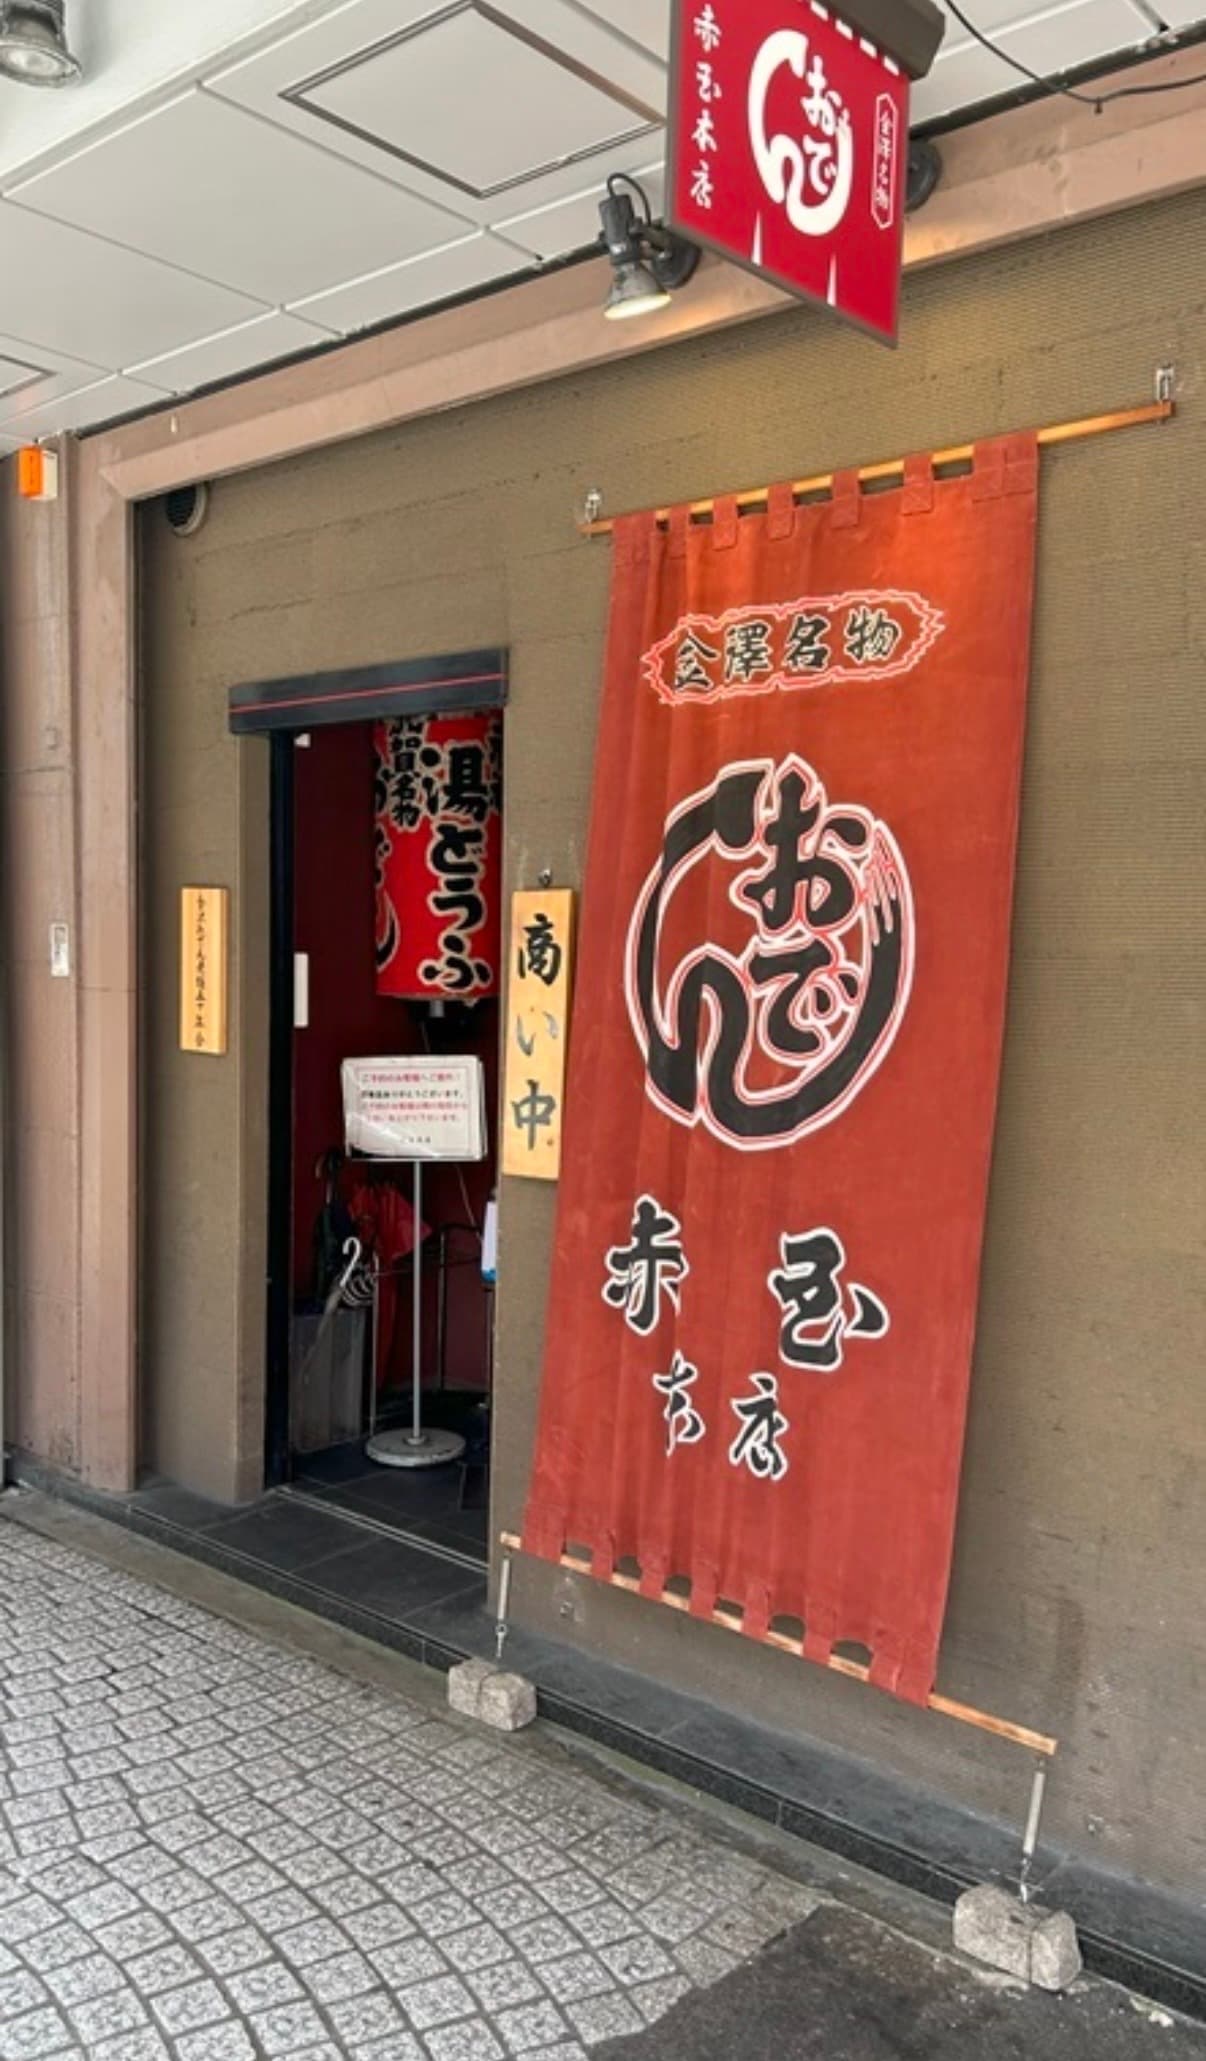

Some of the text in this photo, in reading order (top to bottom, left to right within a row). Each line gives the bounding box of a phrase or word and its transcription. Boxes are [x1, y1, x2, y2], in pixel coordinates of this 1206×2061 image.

[748, 29, 853, 236] おでん
[511, 912, 562, 1151] 商い中
[624, 753, 915, 1151] おでん
